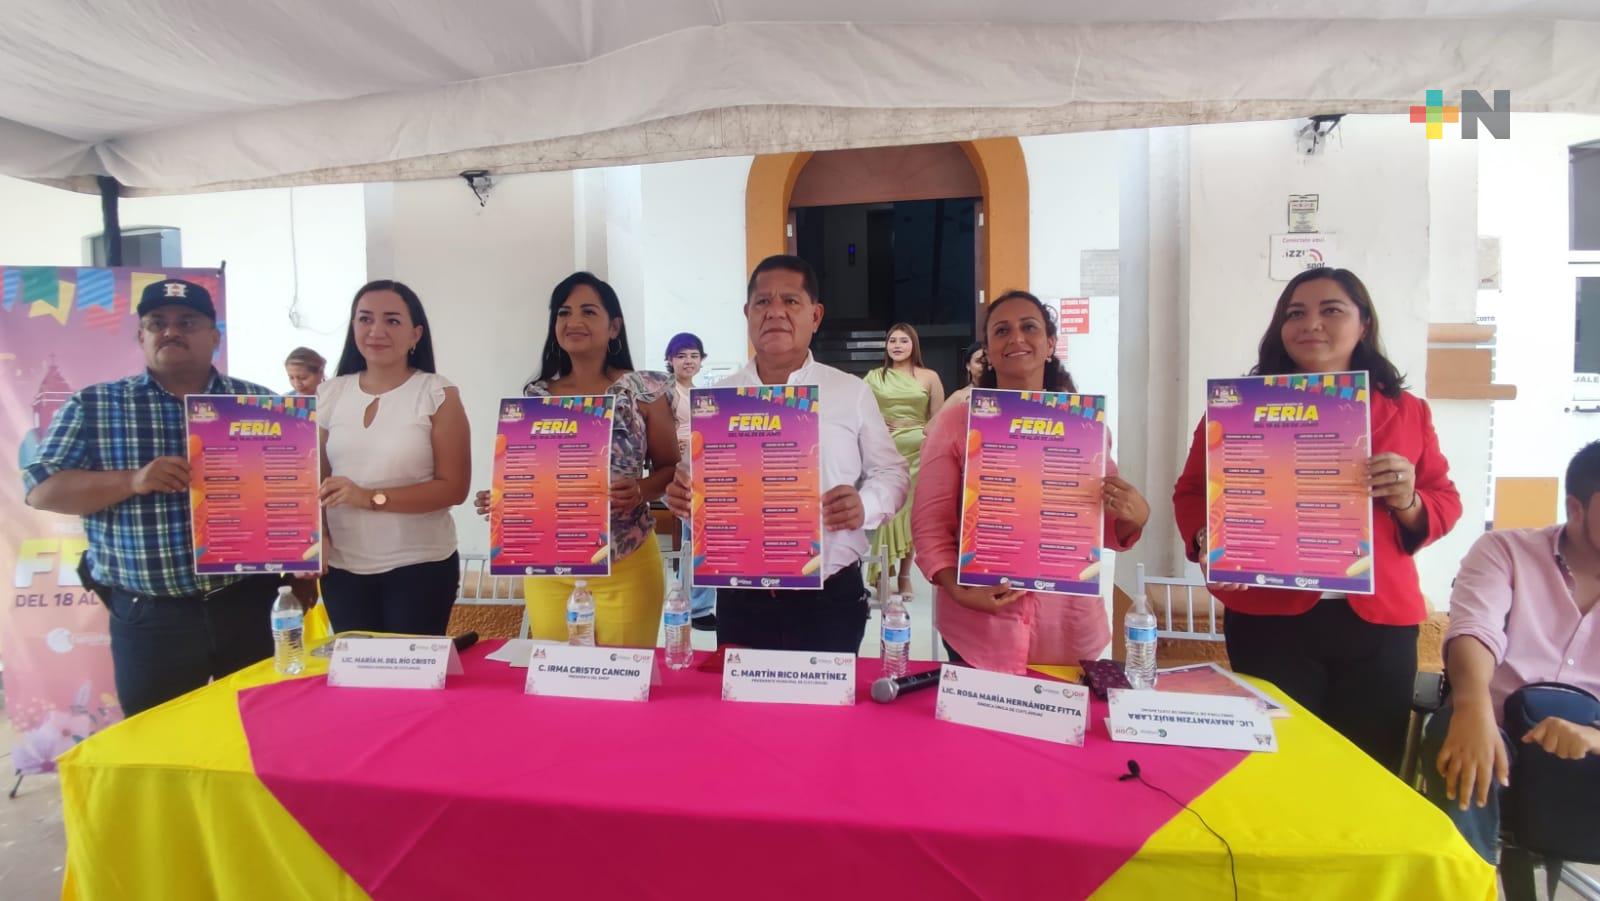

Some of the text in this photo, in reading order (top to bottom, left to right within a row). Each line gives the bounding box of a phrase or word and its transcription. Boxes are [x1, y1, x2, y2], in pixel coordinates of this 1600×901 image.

[1254, 404, 1319, 422] FERIA
[229, 422, 282, 436] FERIA
[530, 420, 578, 434] FERIA
[728, 415, 782, 431] FERIA
[1009, 419, 1065, 436] FERIA
[15, 592, 100, 608] DEL 18 AL
[411, 658, 437, 666] CRISTO
[538, 664, 641, 678] C. IRMA CRISTO CANCINO
[731, 669, 848, 681] C. MARTÍN RICO MARTÍNEZ
[941, 687, 1082, 718] LIC. ROSA MARÍA HERNÁNDEZ FITTA
[1128, 712, 1151, 721] LARA
[1172, 716, 1236, 727] ANAYANTZIN
